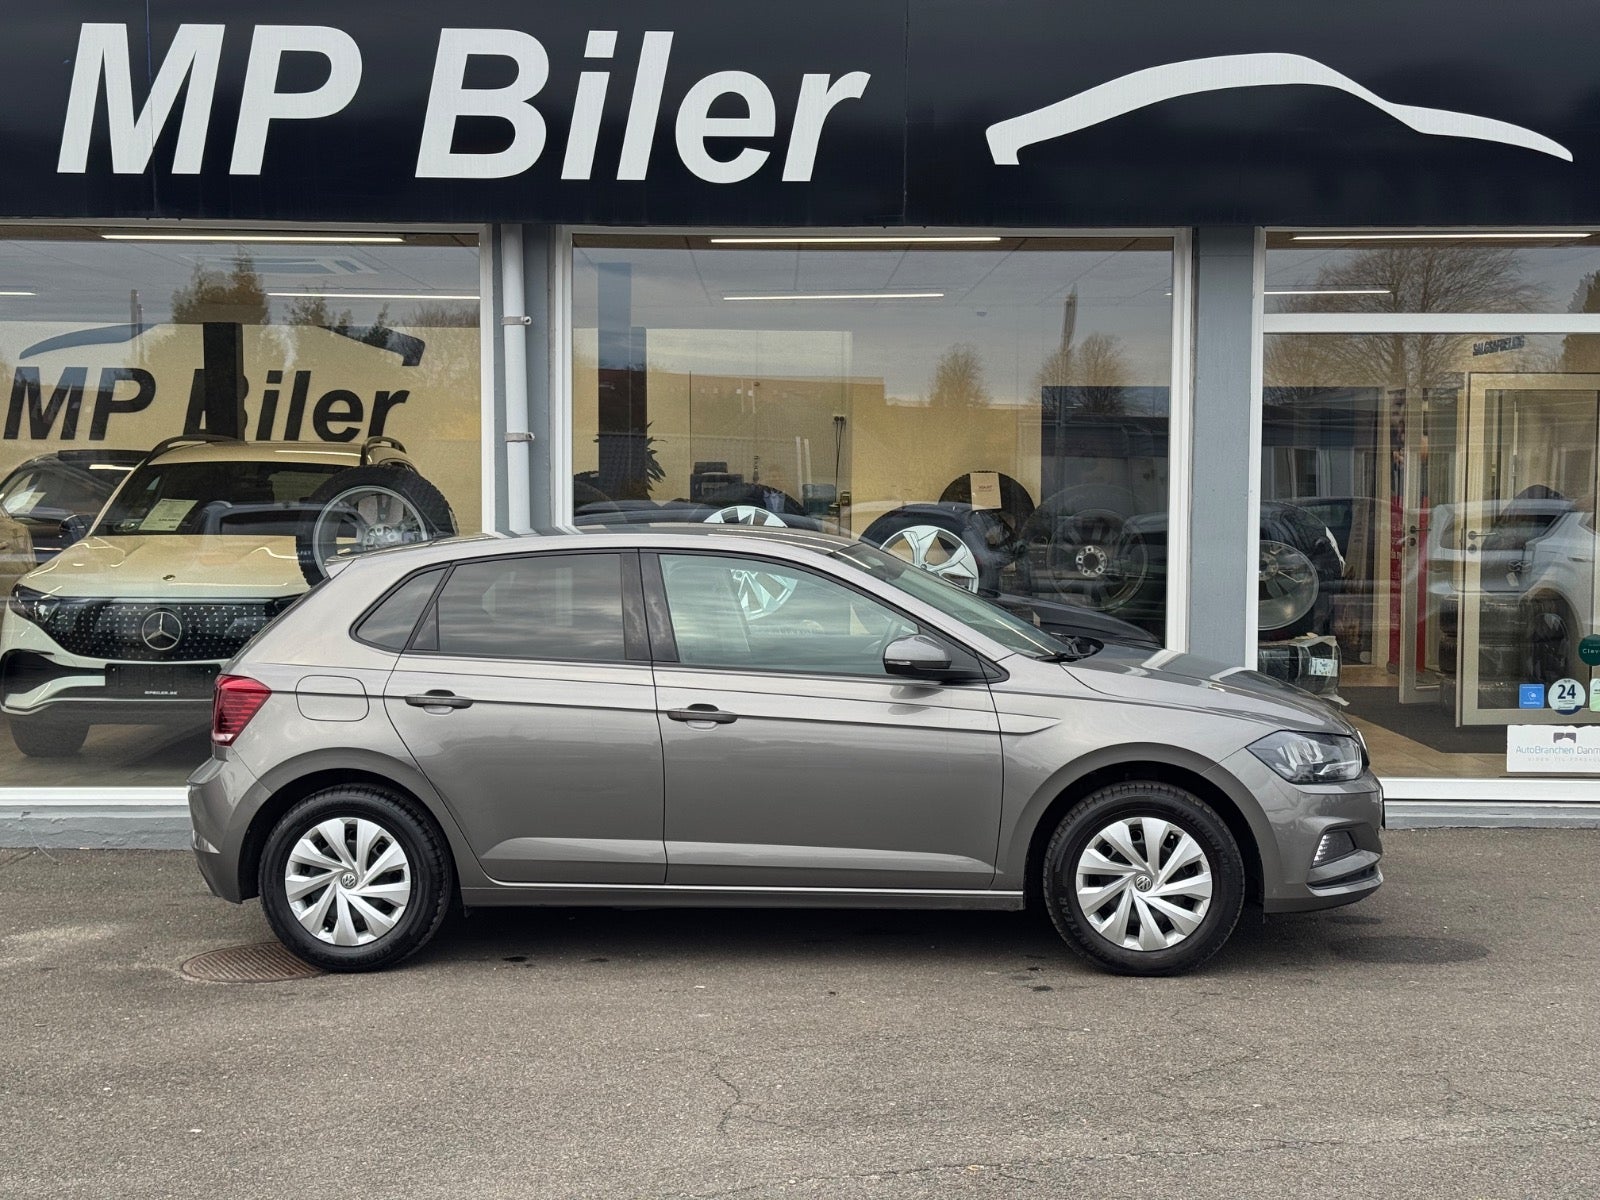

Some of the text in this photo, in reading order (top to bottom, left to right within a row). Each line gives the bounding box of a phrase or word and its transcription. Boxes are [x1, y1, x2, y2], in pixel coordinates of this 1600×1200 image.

[57, 23, 871, 184] MP Biler
[4, 366, 157, 441] MP
[1557, 684, 1576, 699] 24
[1516, 745, 1575, 755] AutoBranchen
